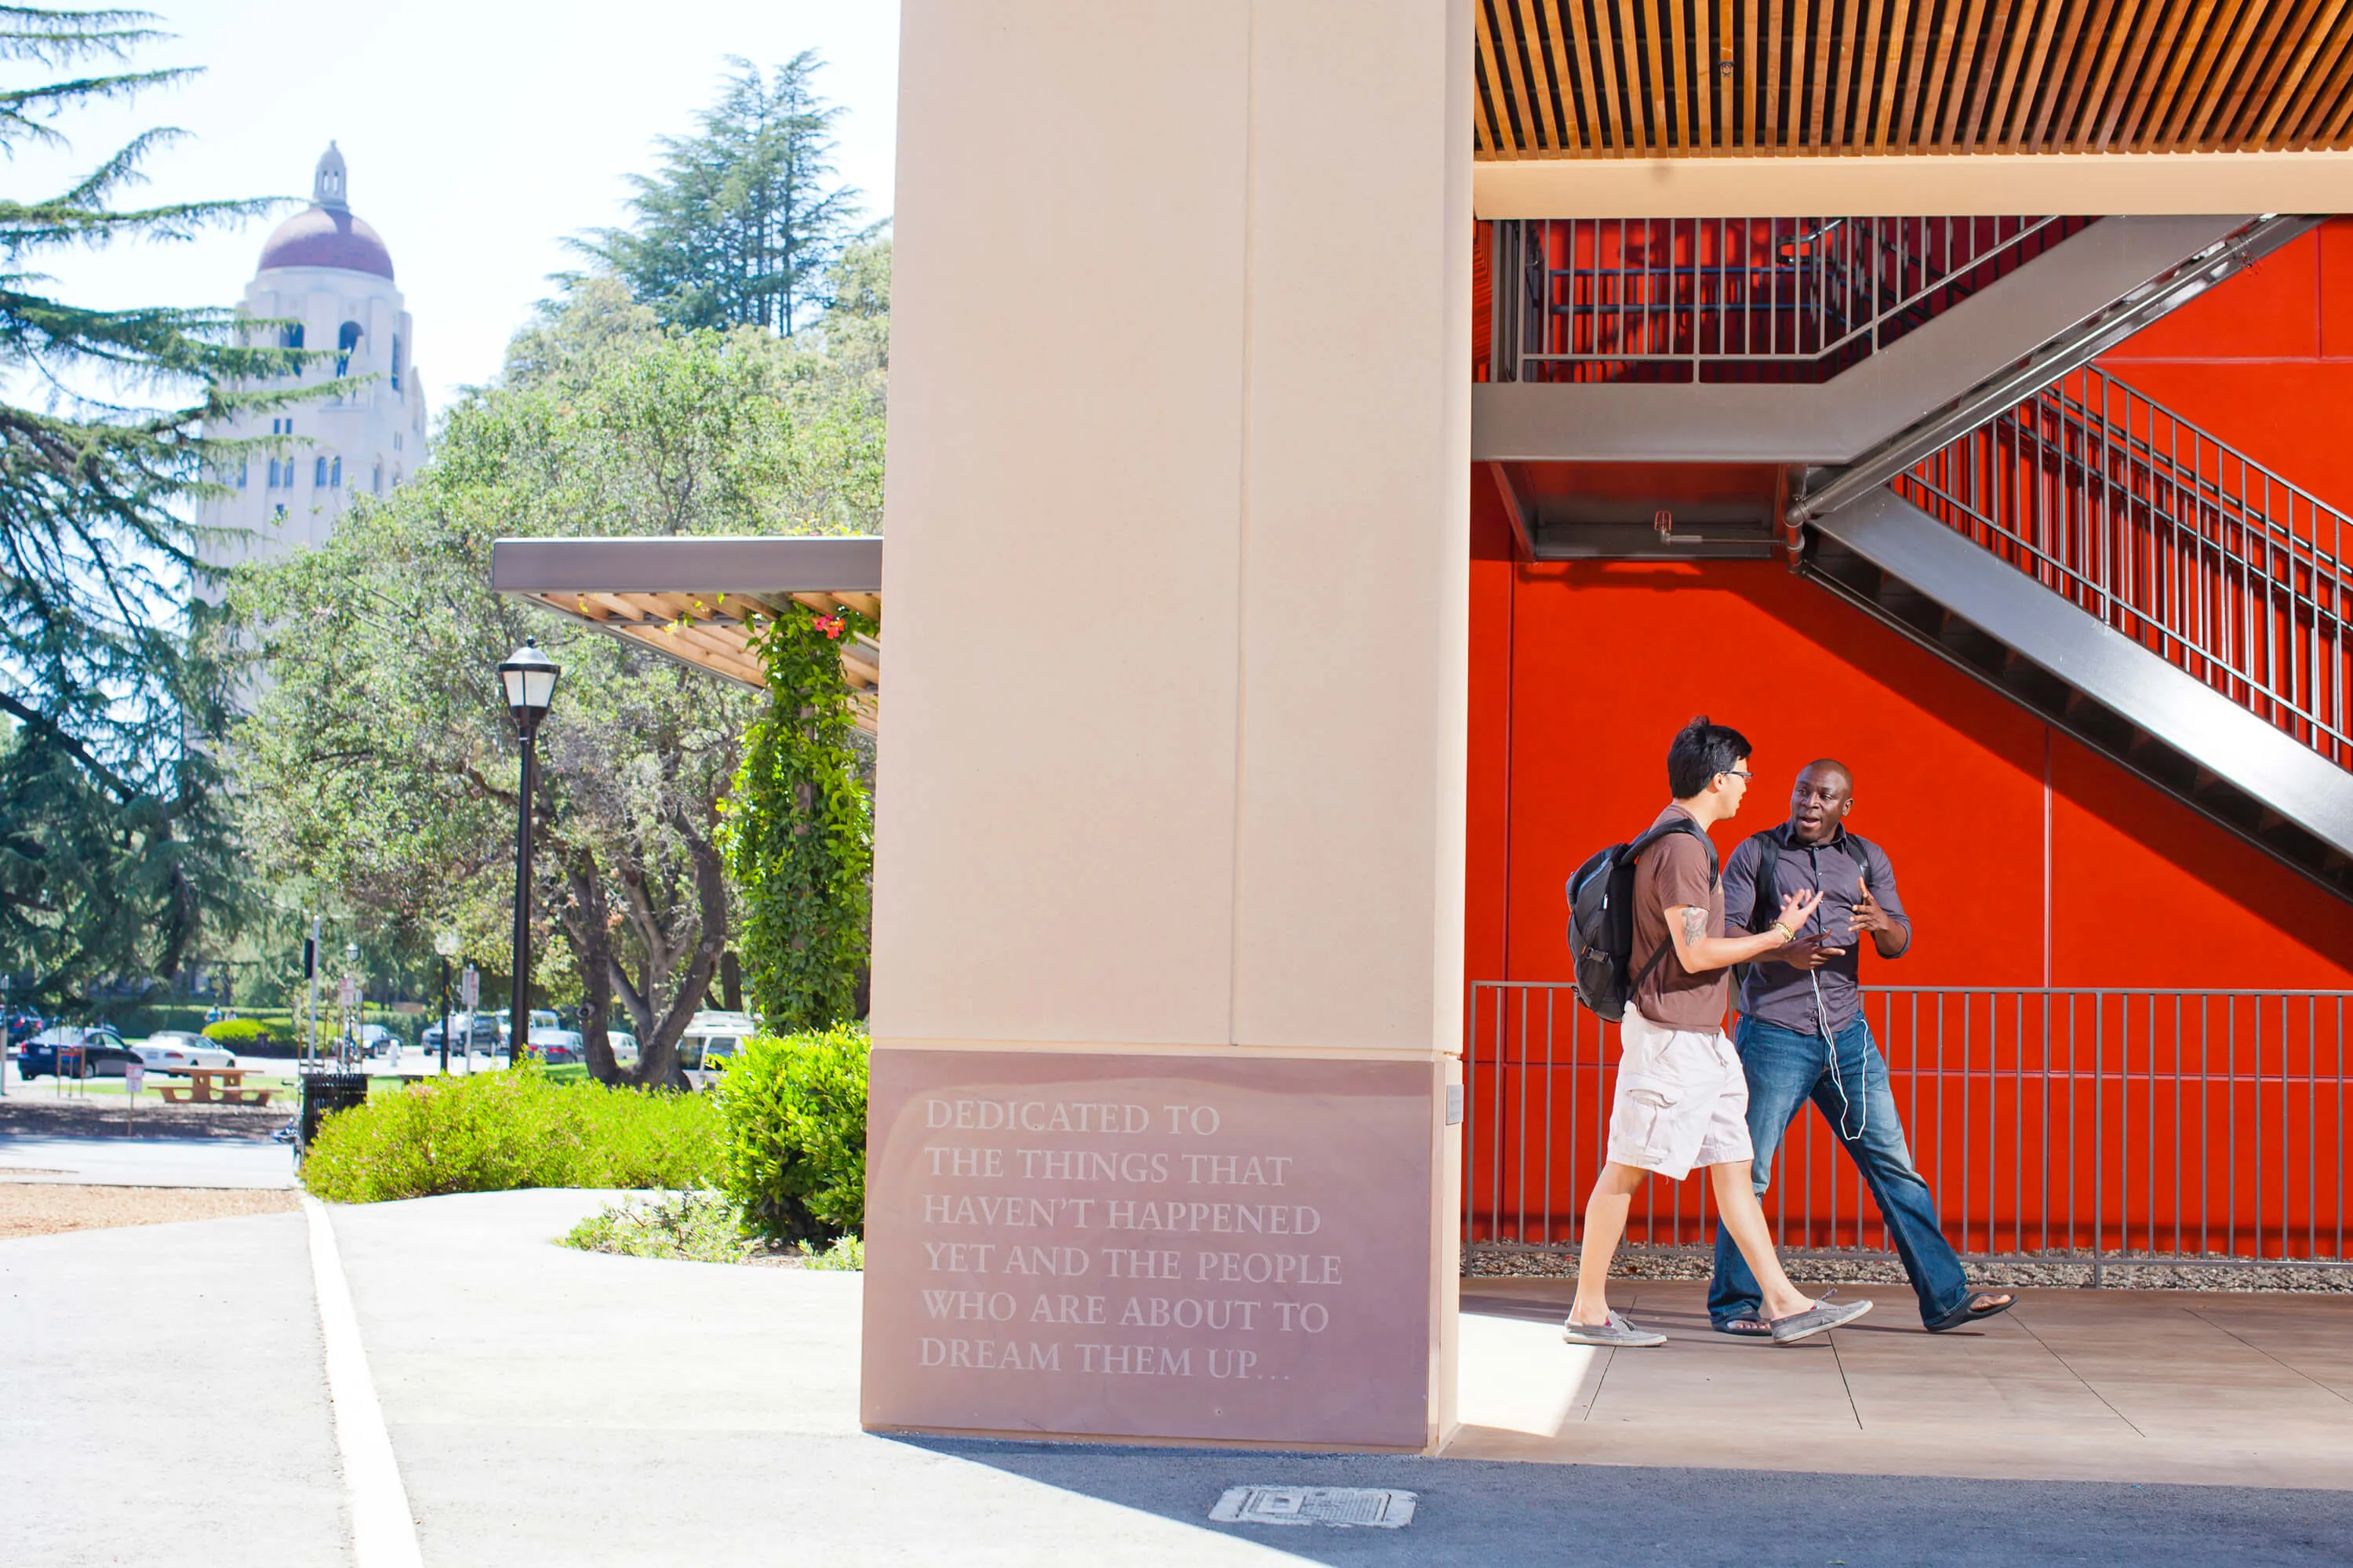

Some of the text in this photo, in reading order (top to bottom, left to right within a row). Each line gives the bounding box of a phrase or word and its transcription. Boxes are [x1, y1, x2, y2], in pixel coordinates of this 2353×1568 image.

[925, 1100, 1220, 1136] DEDICATED TO
[924, 1147, 1292, 1186] THE THINGS THAT
[1107, 1201, 1321, 1235] HAPPENED
[924, 1243, 1342, 1285] YET AND THE PEOPLE
[921, 1290, 1329, 1333] WHO ARE ABOUT TO
[918, 1337, 1061, 1371] DREAM
[1075, 1344, 1192, 1377] THEM
